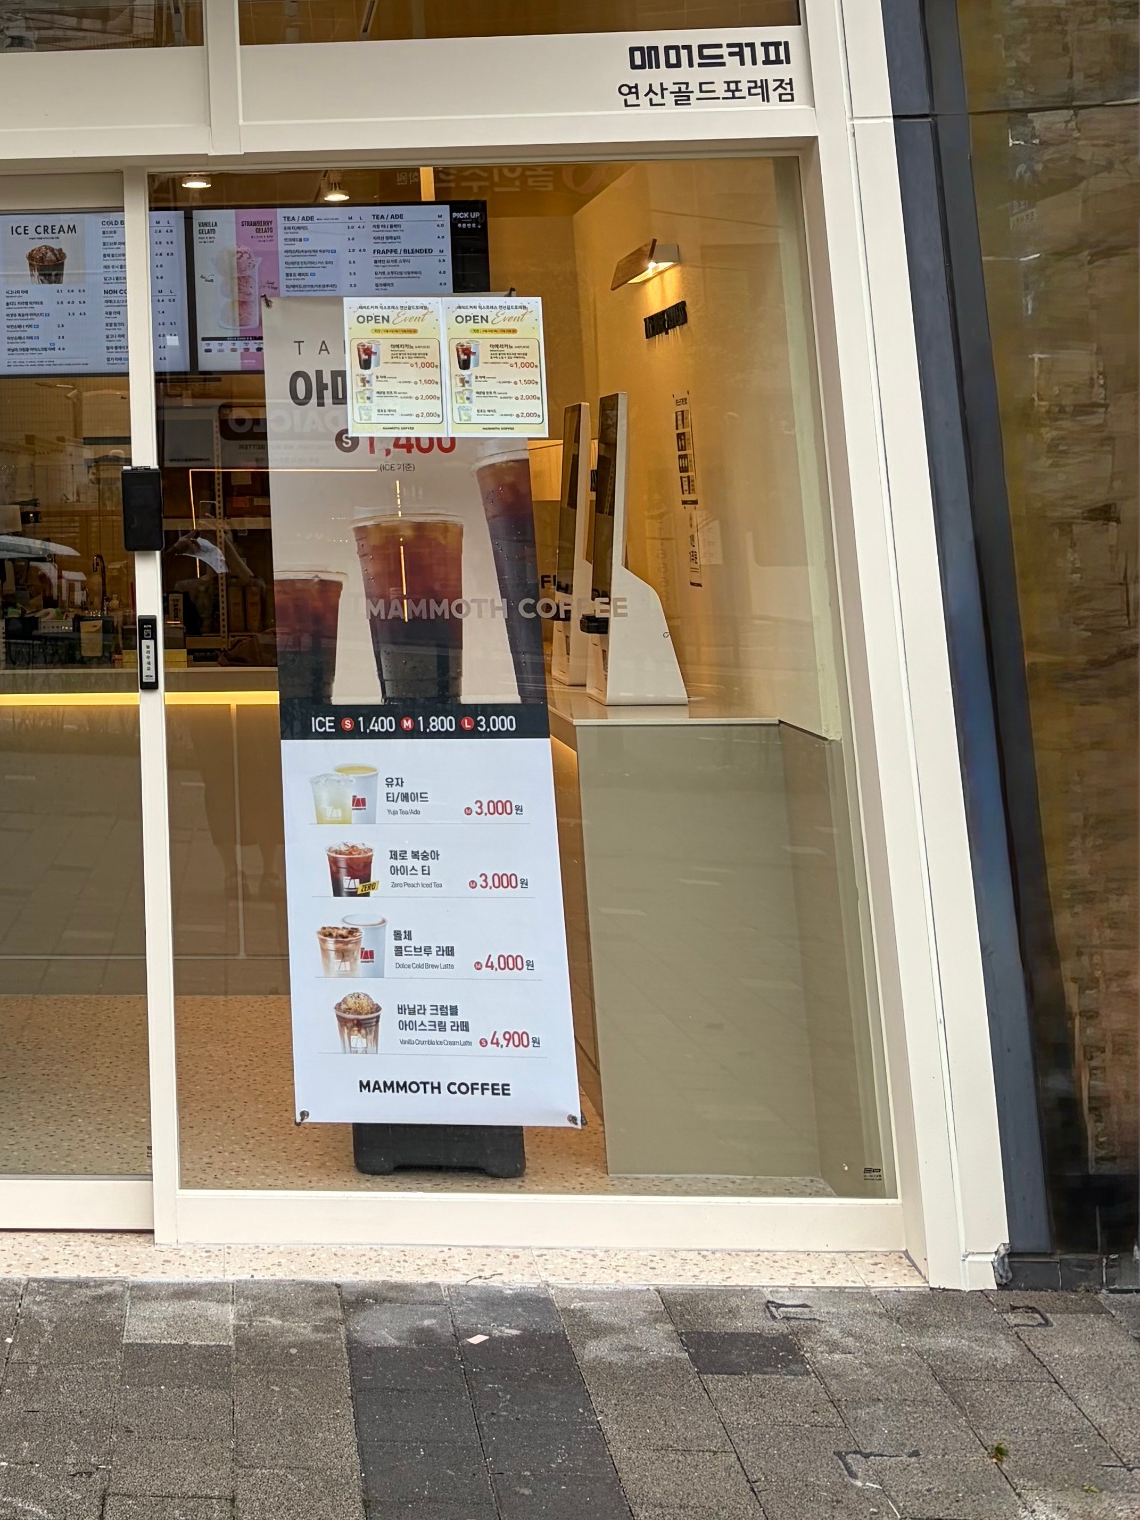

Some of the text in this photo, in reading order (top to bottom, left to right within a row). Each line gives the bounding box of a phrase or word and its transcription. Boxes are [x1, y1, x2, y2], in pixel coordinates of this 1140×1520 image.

[628, 41, 791, 70] 매머드커피
[618, 78, 795, 108] 연산골드포레점
[11, 224, 77, 235] ICE CREAM
[356, 310, 434, 325] OPEN Event
[454, 310, 533, 325] OPEN Event
[294, 340, 346, 355] TA
[368, 436, 456, 456] 1,400
[380, 462, 416, 472] (ICE 기준)
[366, 596, 629, 620] MAMMOTH COFFEE
[311, 716, 336, 732] ICE
[358, 716, 396, 734] 1,400
[418, 716, 456, 733] 1,800
[476, 715, 516, 732] 3,000
[384, 777, 404, 788] 유자
[386, 792, 429, 803] 티/에이드
[389, 850, 440, 861] 제로 복숭아
[390, 864, 431, 876] 아이스 티
[360, 882, 376, 893] ZERO
[393, 930, 412, 942] 돌체
[394, 946, 455, 958] 콜드브루 라떼
[397, 1004, 459, 1016] 바닐라 크럼블
[398, 1020, 470, 1032] 아이스크림 라떼
[359, 1080, 512, 1096] MAMMOTH COFFEE
